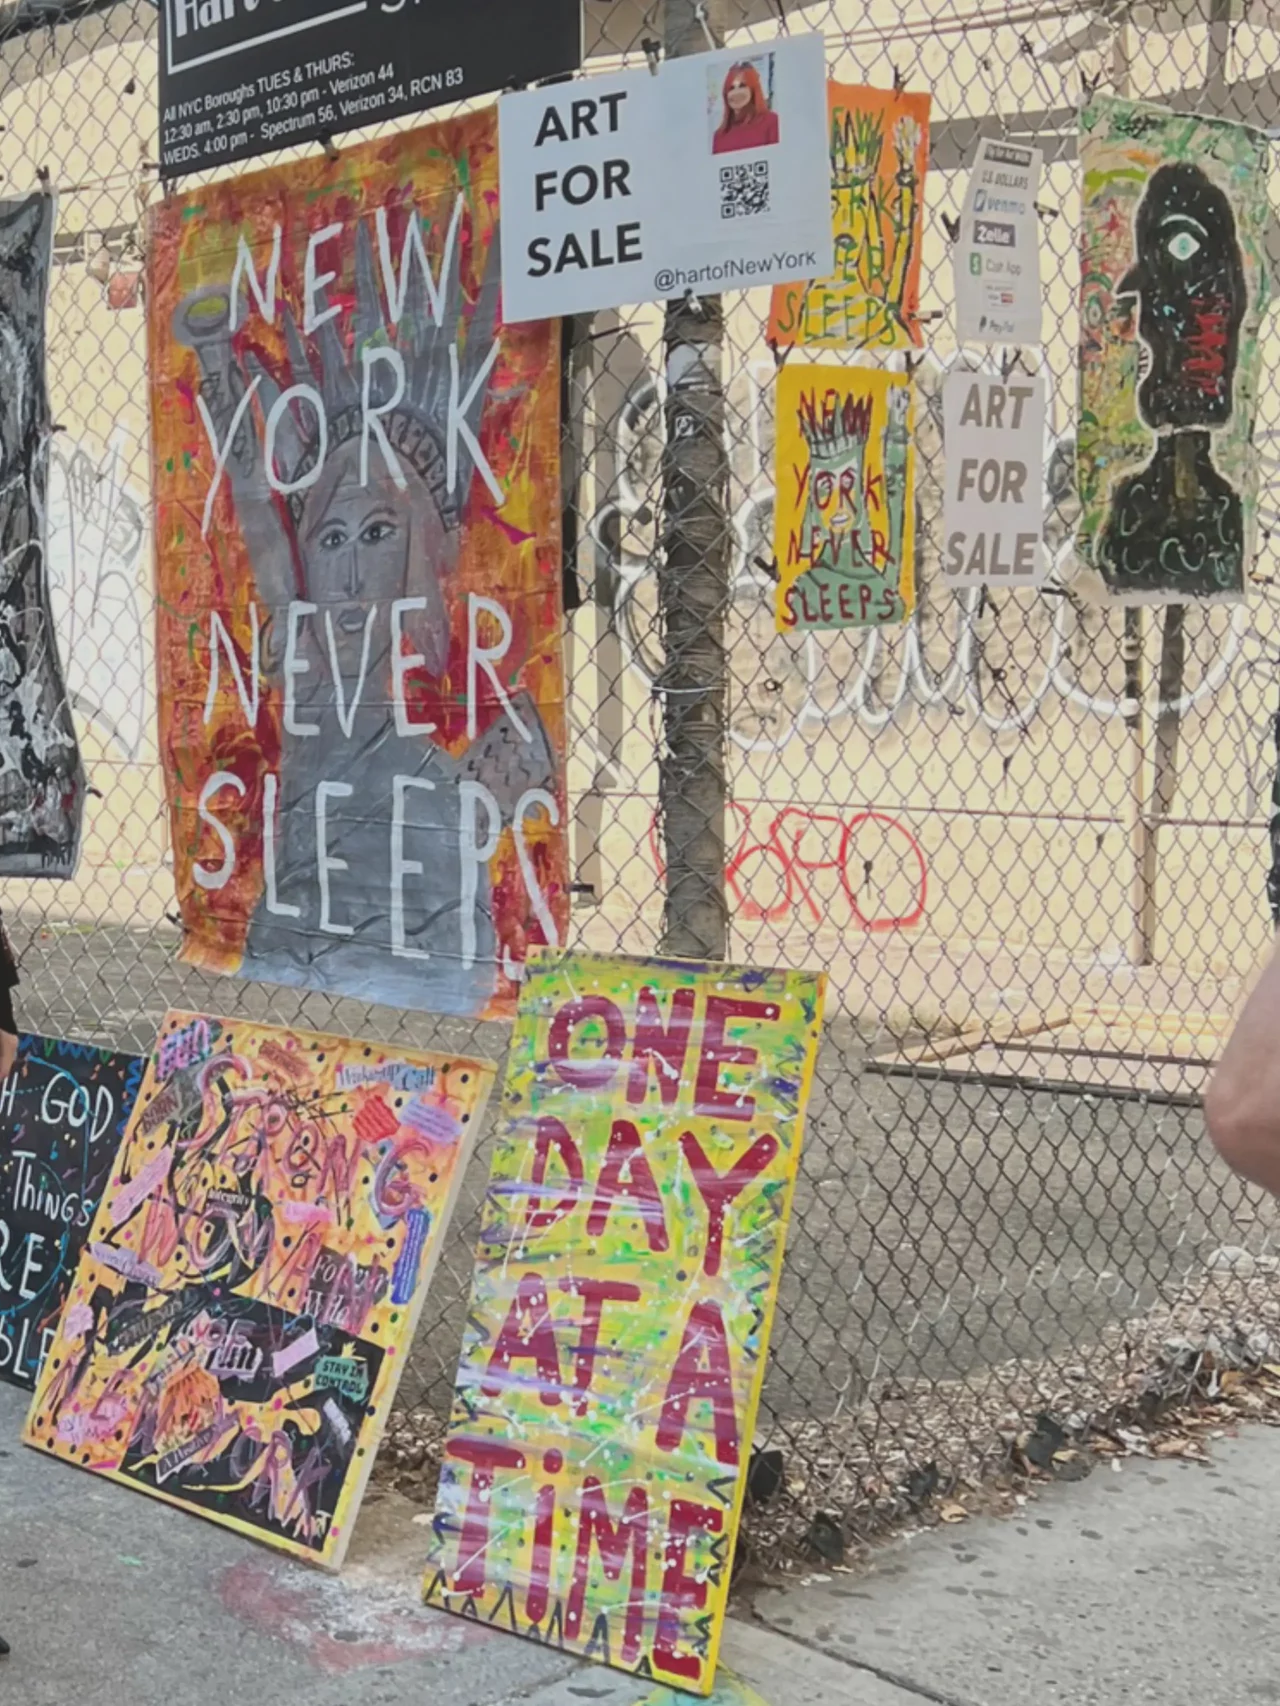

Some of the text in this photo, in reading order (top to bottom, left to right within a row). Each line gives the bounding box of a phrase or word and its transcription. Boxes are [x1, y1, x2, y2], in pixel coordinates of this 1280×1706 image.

[163, 52, 355, 123] All NYC Boroughs TUES & THURS:
[163, 120, 192, 142] 12:30
[192, 119, 215, 134] am,
[216, 111, 240, 129] 2:30
[242, 105, 264, 126] pm,
[266, 93, 298, 116] 10:30
[300, 88, 320, 109] pm
[329, 71, 376, 97] Verizon
[377, 62, 395, 81] 44
[204, 135, 228, 154] 4:00
[229, 129, 249, 149] pm
[260, 110, 316, 141] Spectrum
[318, 104, 337, 123] 56,
[340, 90, 386, 117] Verizon
[387, 84, 407, 103] 34,
[410, 72, 443, 96] RCN
[445, 67, 464, 86] 83
[533, 91, 628, 147] ART
[534, 159, 632, 211] FOR
[228, 191, 464, 336] NEW
[526, 221, 643, 278] SALE
[653, 250, 818, 292] @hartofNewYork
[775, 290, 896, 346] SLEEPS
[796, 386, 874, 438] NEW
[959, 383, 1034, 429] ART
[196, 338, 506, 541] YORK
[792, 462, 886, 514] YORK
[957, 458, 1028, 503] FOR
[786, 526, 896, 569] NEVER
[946, 531, 1039, 576] SALE
[782, 583, 898, 627] SLEEPS
[202, 592, 533, 744] NEVER
[192, 770, 561, 981] SLEEPS
[548, 985, 781, 1122] ONE
[41, 1071, 114, 1143] GOD
[525, 1115, 780, 1277] DAY
[322, 1360, 349, 1376] STAY
[480, 1271, 740, 1466] AT A
